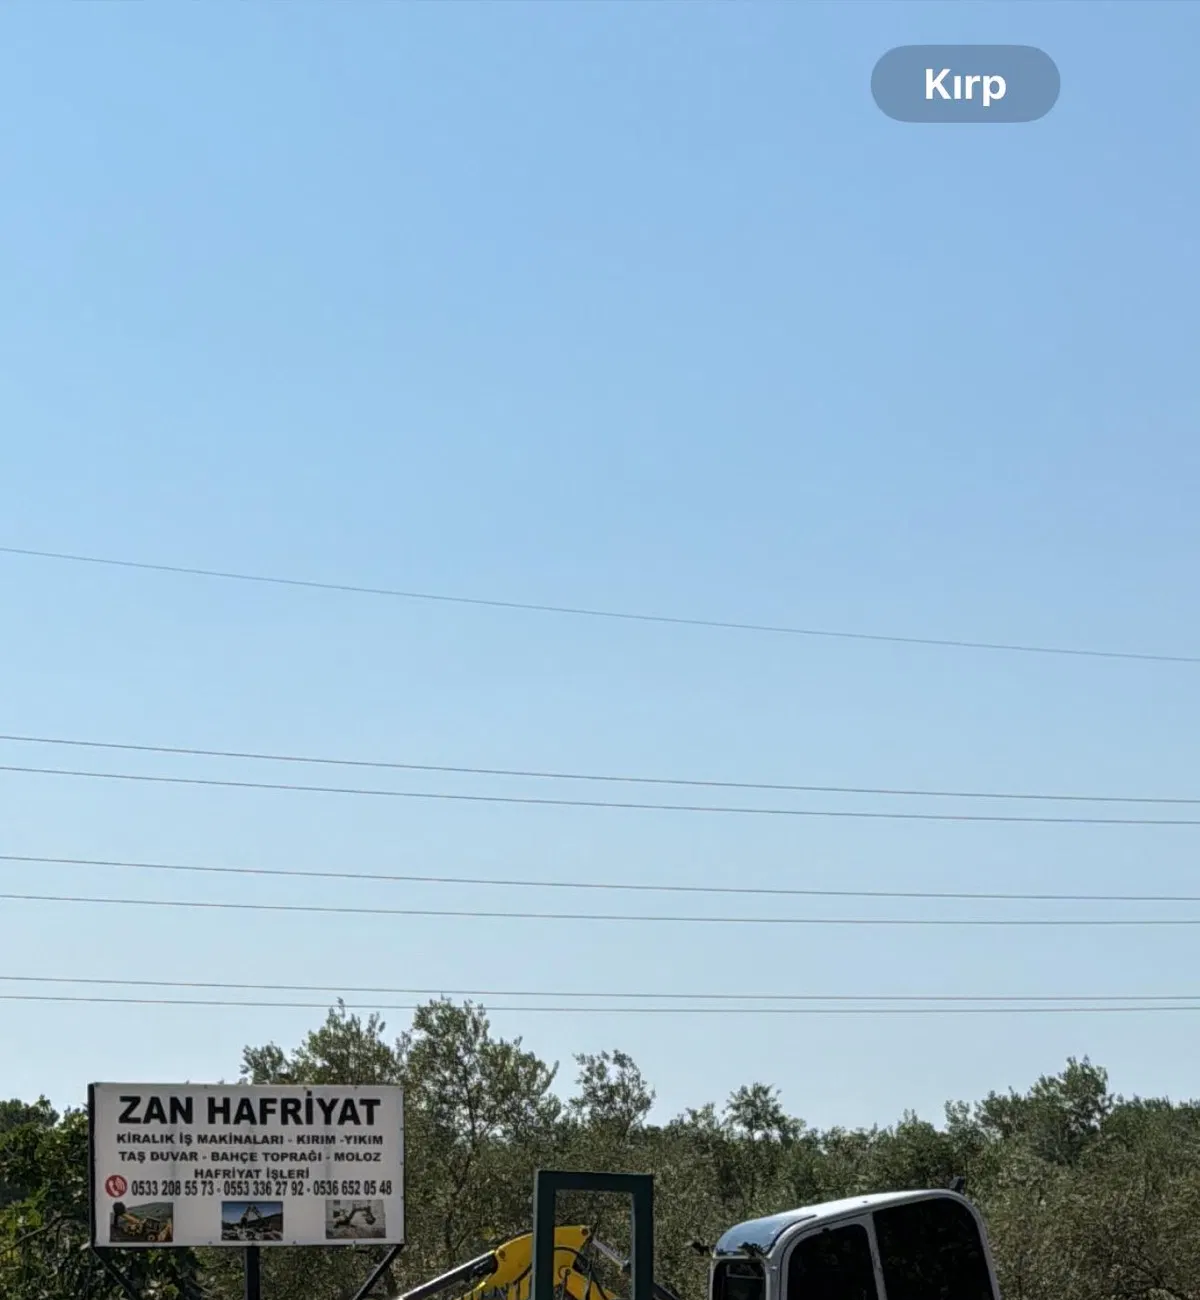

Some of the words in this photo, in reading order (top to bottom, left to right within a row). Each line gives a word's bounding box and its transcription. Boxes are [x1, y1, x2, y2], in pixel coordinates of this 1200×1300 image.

[118, 1096, 193, 1125] ZAN
[207, 1090, 381, 1126] HAFRİYAT
[116, 1131, 175, 1145] KİRALIK
[179, 1131, 193, 1147] İŞ
[197, 1132, 284, 1145] MAKİNALARI
[296, 1134, 336, 1145] KIRIM
[118, 1151, 146, 1164] TAŞ
[150, 1151, 198, 1162] DUVAR
[210, 1151, 258, 1164] BAHÇE
[262, 1149, 322, 1162] TOPRAĞI
[334, 1152, 382, 1162] MOLOZ
[194, 1167, 262, 1179] HAFRİYAT
[266, 1167, 310, 1181] İŞLERİ
[131, 1180, 158, 1197] 0533
[161, 1180, 181, 1197] 208
[184, 1180, 198, 1197] 55
[201, 1180, 214, 1197] 73
[223, 1180, 249, 1197] 0553
[252, 1180, 272, 1197] 336
[275, 1180, 288, 1197] 27
[291, 1180, 304, 1197] 92
[313, 1180, 339, 1197] 0536
[341, 1180, 361, 1197] 652
[363, 1180, 377, 1197] 05
[379, 1180, 392, 1197] 48
